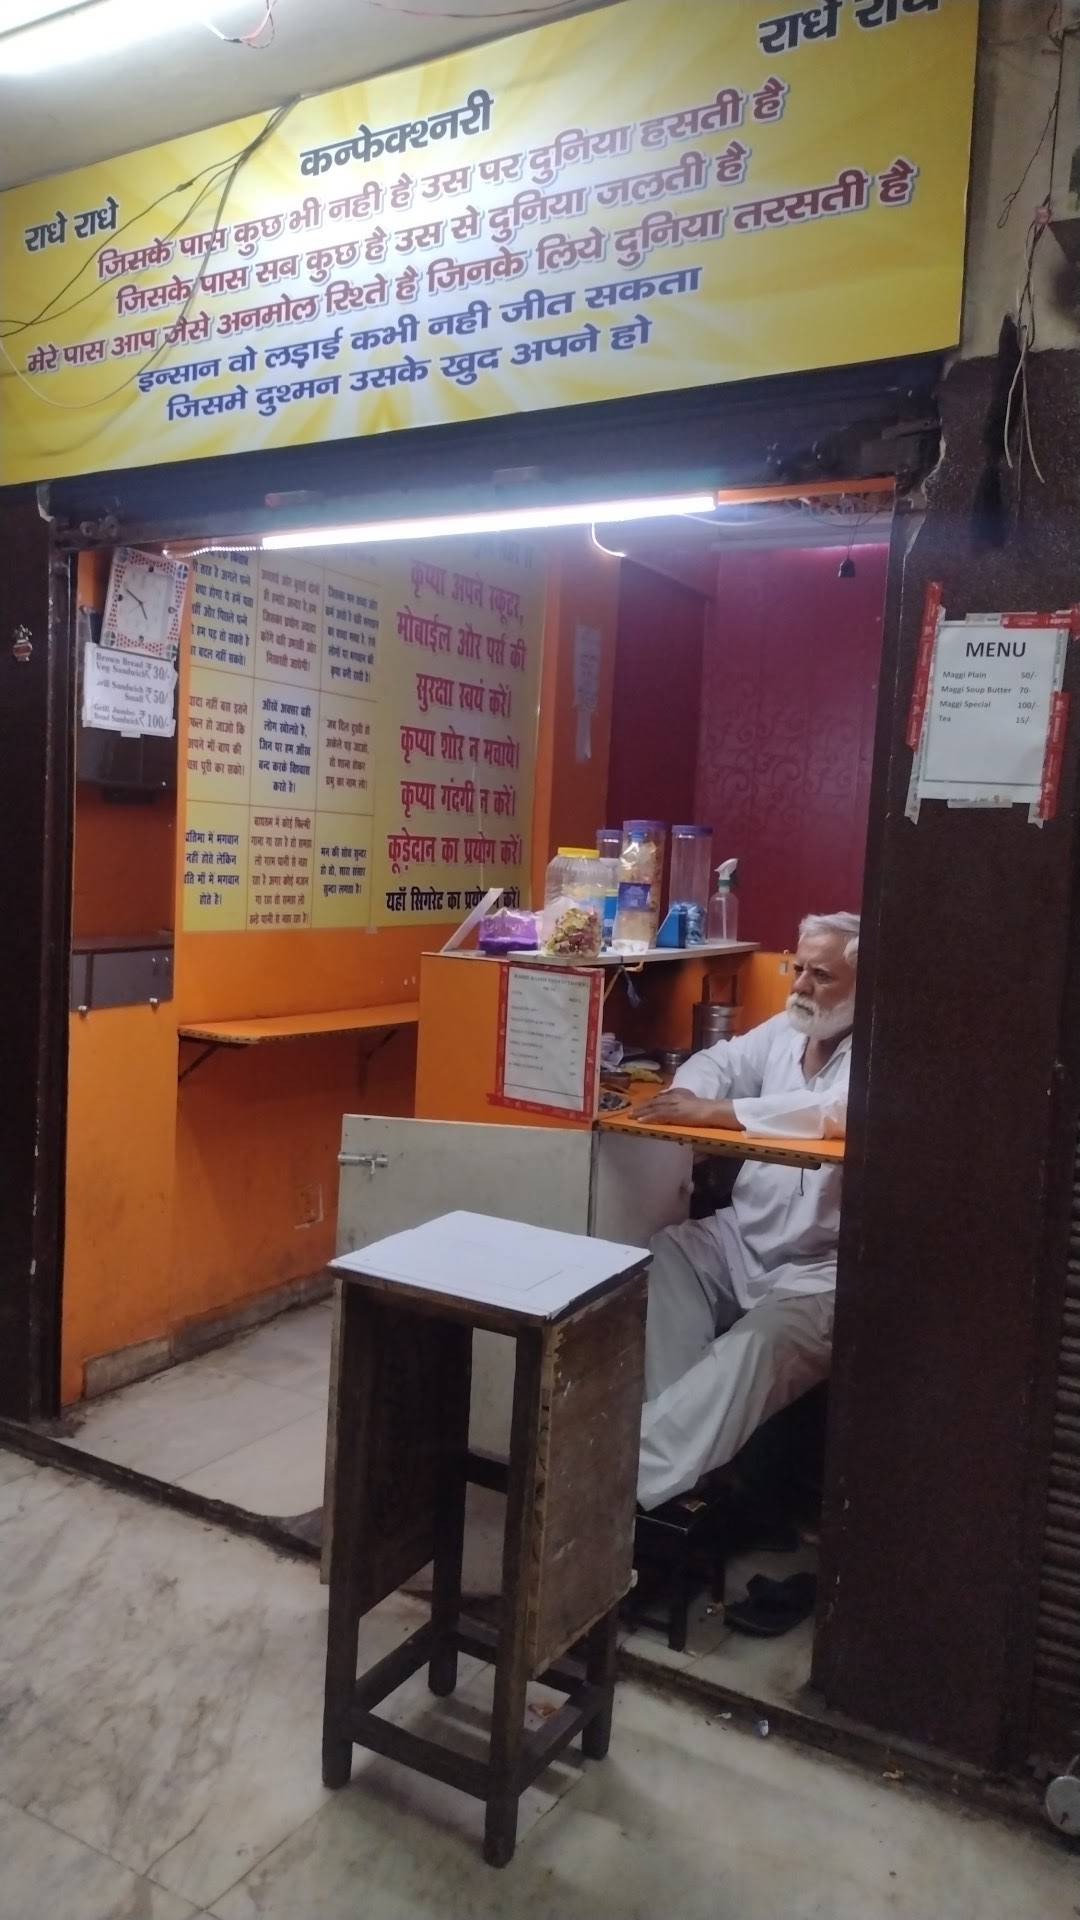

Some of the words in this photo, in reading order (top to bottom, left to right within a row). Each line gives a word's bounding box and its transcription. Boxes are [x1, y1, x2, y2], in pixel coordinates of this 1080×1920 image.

[759, 0, 842, 54] राधे
[97, 239, 172, 280] जिसके
[180, 226, 227, 256] पास
[234, 215, 282, 256] कुछ
[289, 198, 322, 233] भी
[330, 187, 383, 223] नही
[389, 175, 413, 209] है
[422, 164, 469, 199] उस
[479, 154, 521, 185] पर
[530, 131, 633, 184] दुनिया
[641, 90, 742, 149] हसती
[753, 77, 788, 123] है
[24, 207, 66, 253] राधे
[74, 197, 119, 239] राधे
[116, 274, 193, 316] जिसके
[200, 265, 249, 296] पास
[256, 255, 298, 287] सब
[306, 246, 359, 283] कुछ
[365, 230, 387, 263] है
[396, 220, 442, 255] उस
[451, 209, 479, 242] से
[489, 188, 587, 243] दुनिया
[596, 151, 705, 208] जलती
[717, 141, 748, 184] है
[27, 344, 59, 376] मेरे
[65, 340, 105, 368] पास
[112, 327, 158, 358] आप
[164, 314, 209, 351] जैसे
[217, 292, 316, 336] अनमोल
[326, 274, 387, 318] रिश्ते
[396, 263, 416, 298] है
[428, 246, 525, 294] जिनके
[536, 230, 604, 273] लिये
[615, 208, 724, 267] दुनिया
[733, 171, 867, 230] तरसती
[879, 158, 915, 203] है
[138, 360, 219, 395] इन्सान
[230, 347, 256, 373] वो
[351, 314, 420, 352] कभी
[429, 298, 489, 338] नही
[501, 284, 573, 326] जीत
[586, 267, 703, 308] सकता
[168, 387, 247, 421] जिसमे
[257, 377, 339, 417] दुश्मन
[350, 355, 429, 395] उसके
[442, 342, 499, 386] खुद
[511, 324, 598, 367] अपने
[611, 316, 652, 351] हो
[458, 622, 481, 660] और
[510, 638, 527, 672] की
[966, 642, 1026, 657] MENU
[416, 673, 453, 711] सुरक्षा
[441, 726, 464, 761] शोर
[469, 737, 480, 762] न
[441, 777, 475, 814] गंदगी
[480, 789, 488, 814] न
[441, 836, 458, 864] का
[464, 831, 496, 865] प्रयोग
[411, 887, 444, 910] सिगरेट
[448, 892, 461, 909] का
